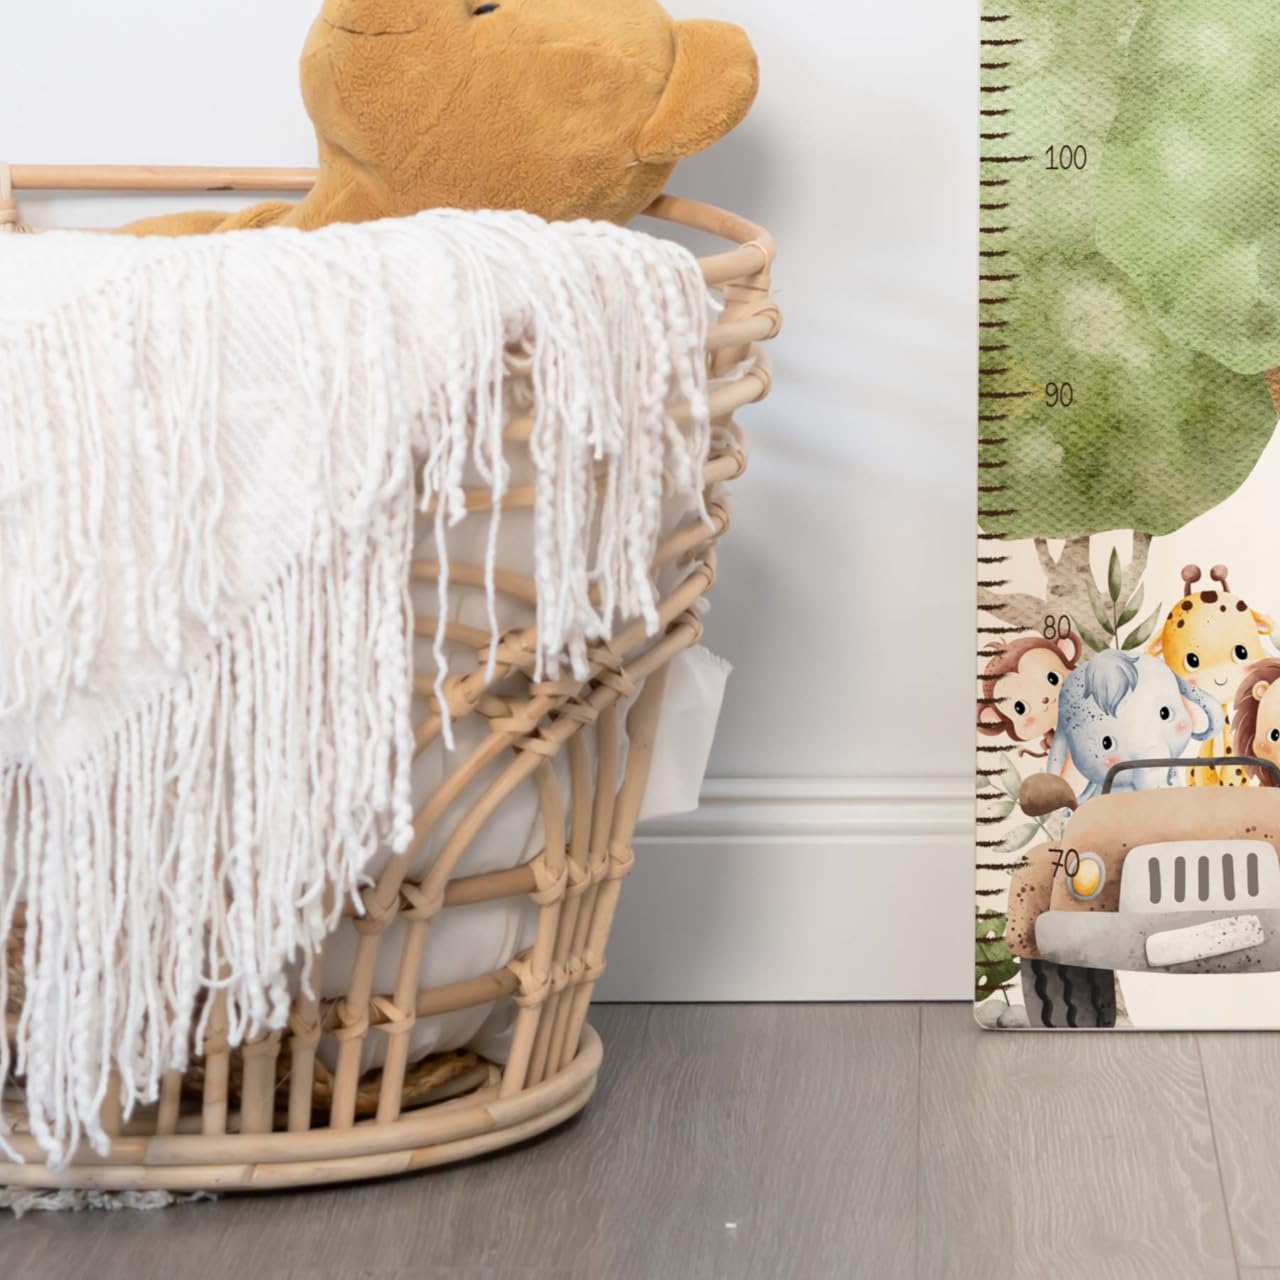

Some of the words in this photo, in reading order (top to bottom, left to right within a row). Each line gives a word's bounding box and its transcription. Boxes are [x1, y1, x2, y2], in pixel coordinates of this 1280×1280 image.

[1045, 145, 1087, 170] 100
[1045, 382, 1073, 408] 90
[1043, 614, 1071, 640] 80
[1048, 848, 1080, 878] 70
